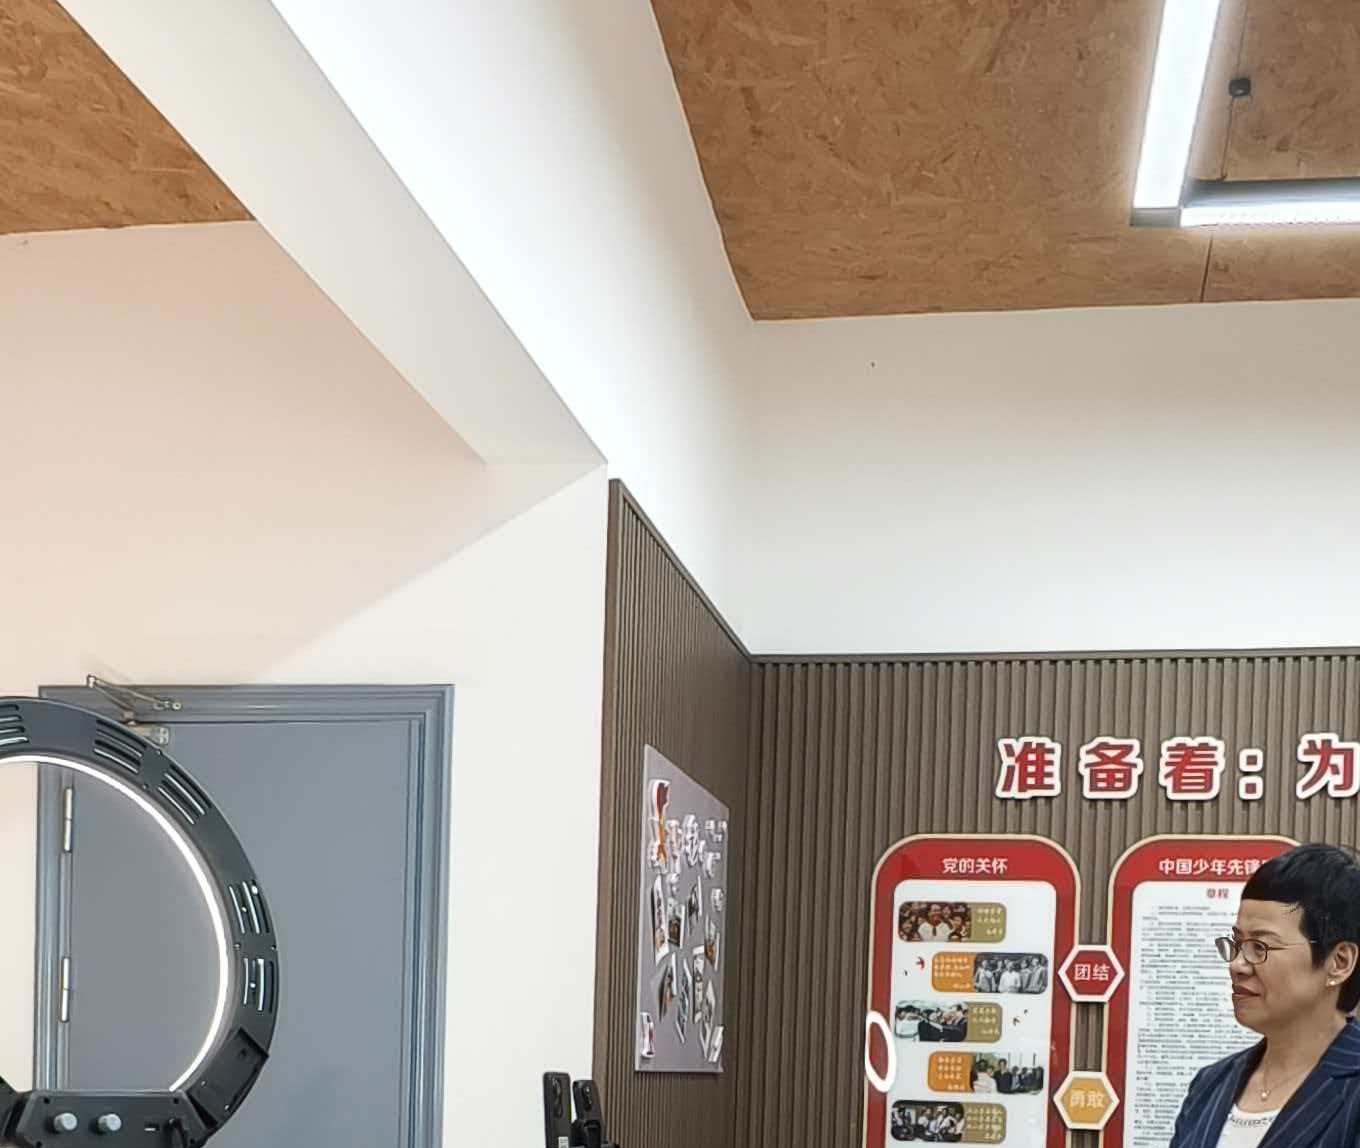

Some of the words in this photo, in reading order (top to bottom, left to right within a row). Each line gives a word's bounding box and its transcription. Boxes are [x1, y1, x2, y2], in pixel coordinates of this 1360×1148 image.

[942, 857, 1008, 874] 党的关怀
[1159, 858, 1268, 875] 中国少年先锋
[1074, 963, 1110, 982] 团结
